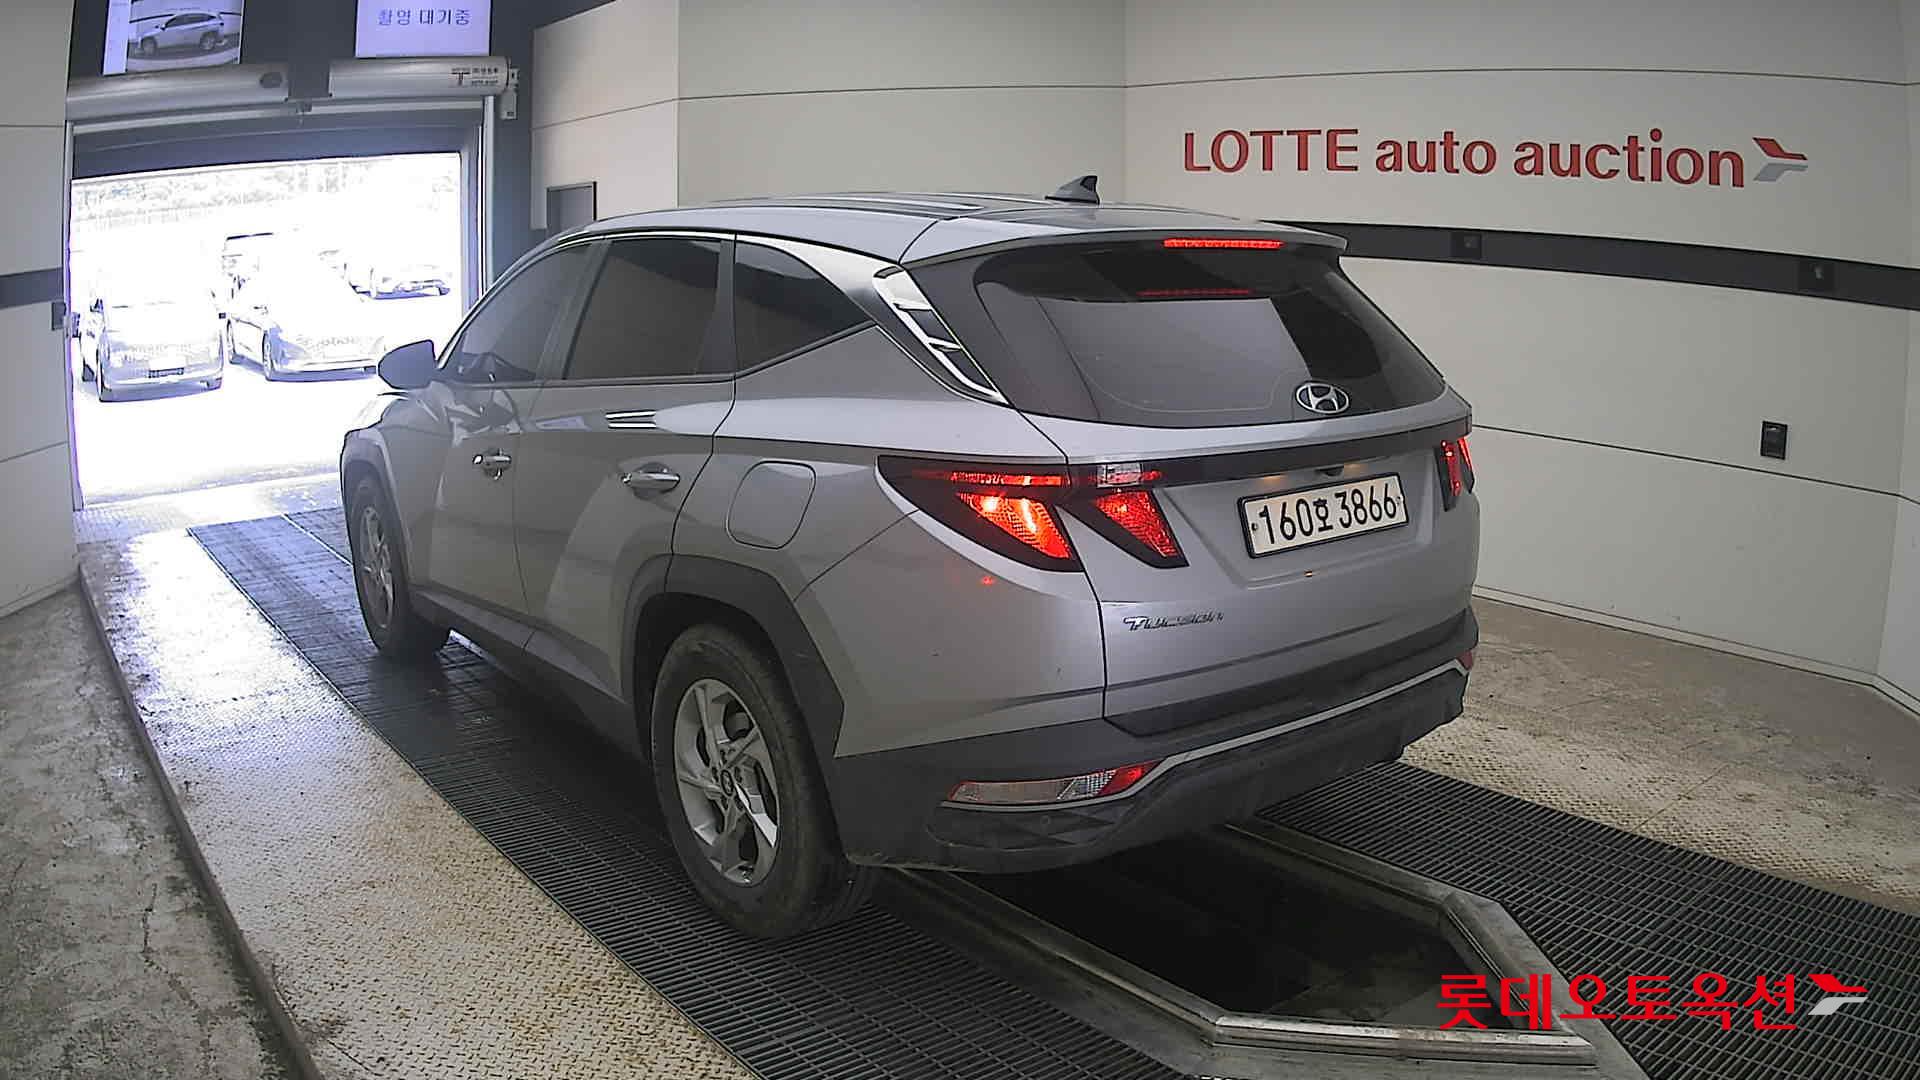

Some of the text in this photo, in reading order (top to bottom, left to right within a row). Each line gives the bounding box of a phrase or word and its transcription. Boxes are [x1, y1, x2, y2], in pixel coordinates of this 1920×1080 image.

[419, 8, 470, 26] 대기중
[1183, 128, 1745, 188] LOTTE auto auction
